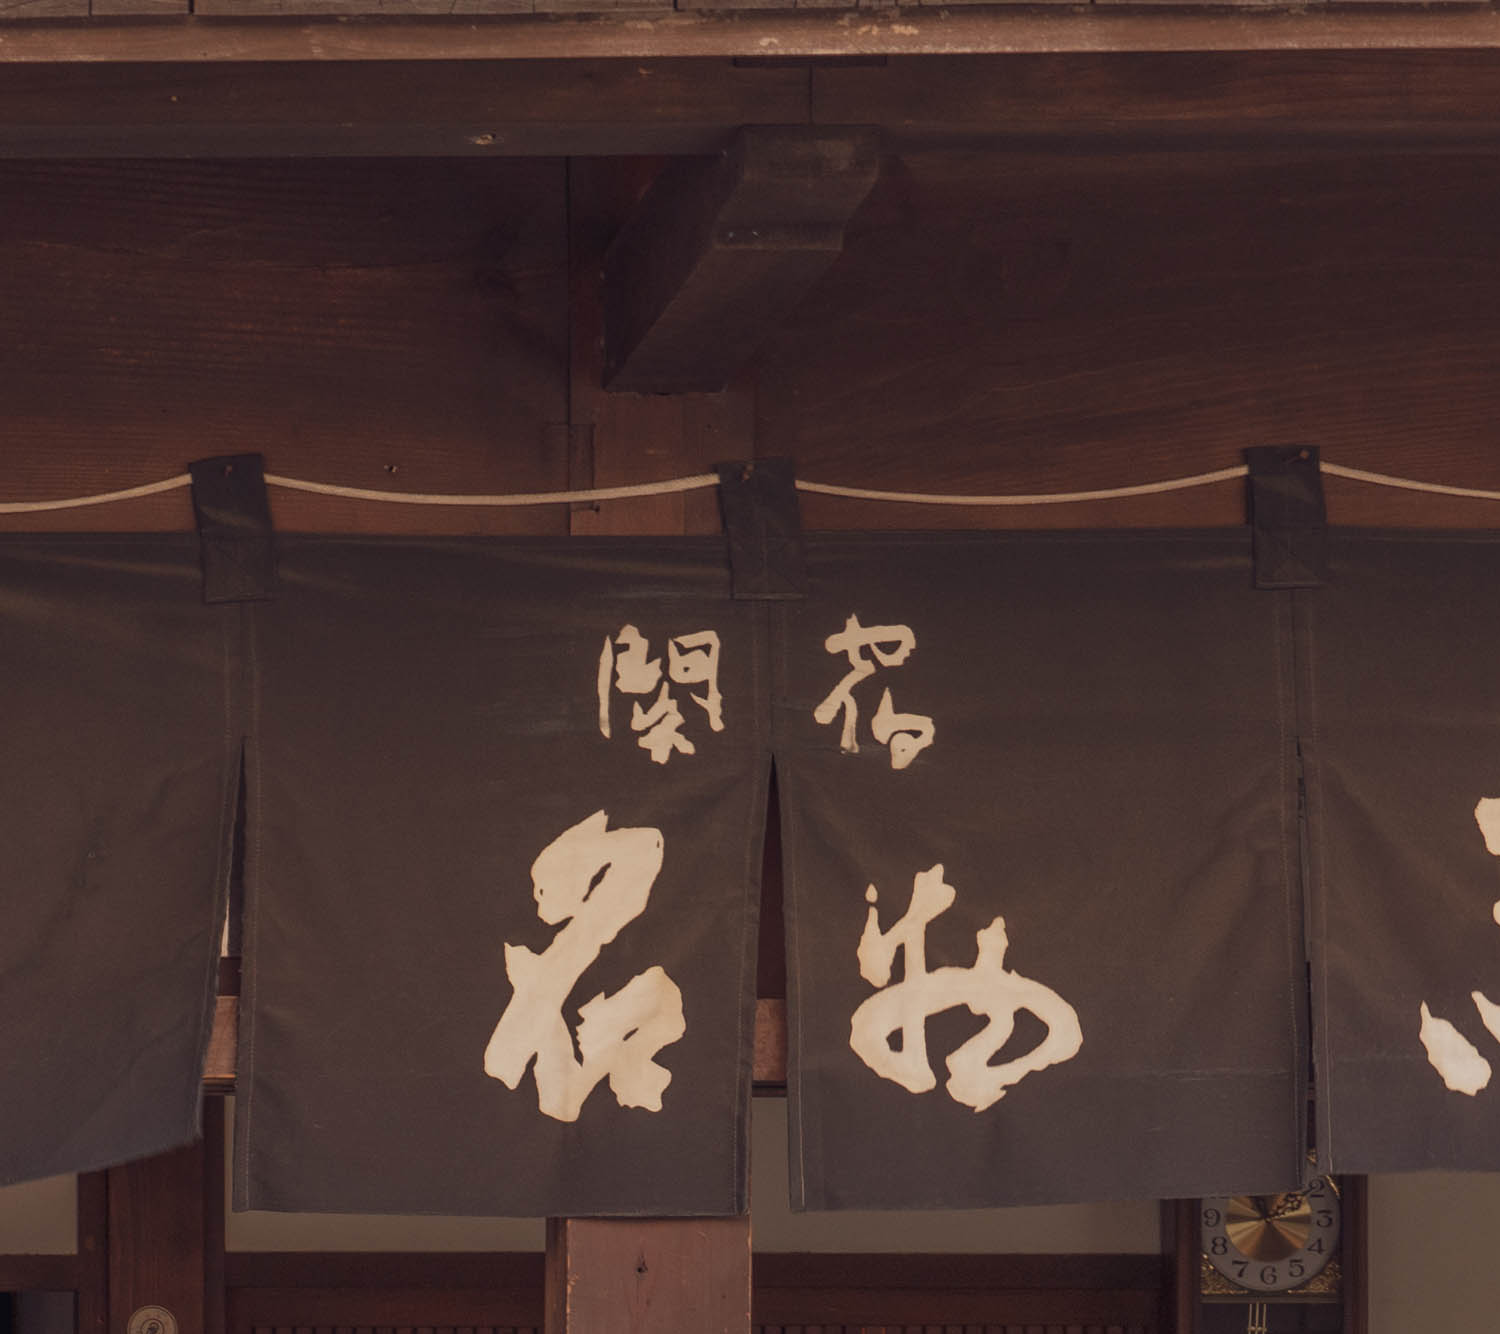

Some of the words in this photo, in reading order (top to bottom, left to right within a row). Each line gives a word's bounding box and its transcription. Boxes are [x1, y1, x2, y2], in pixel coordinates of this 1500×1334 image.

[1204, 1208, 1221, 1227] 9
[1316, 1209, 1333, 1227] 3
[1211, 1236, 1228, 1255] 8
[1307, 1238, 1325, 1254] 4
[1231, 1260, 1249, 1278] 7
[1260, 1266, 1277, 1285] 6
[1288, 1259, 1305, 1278] 5
